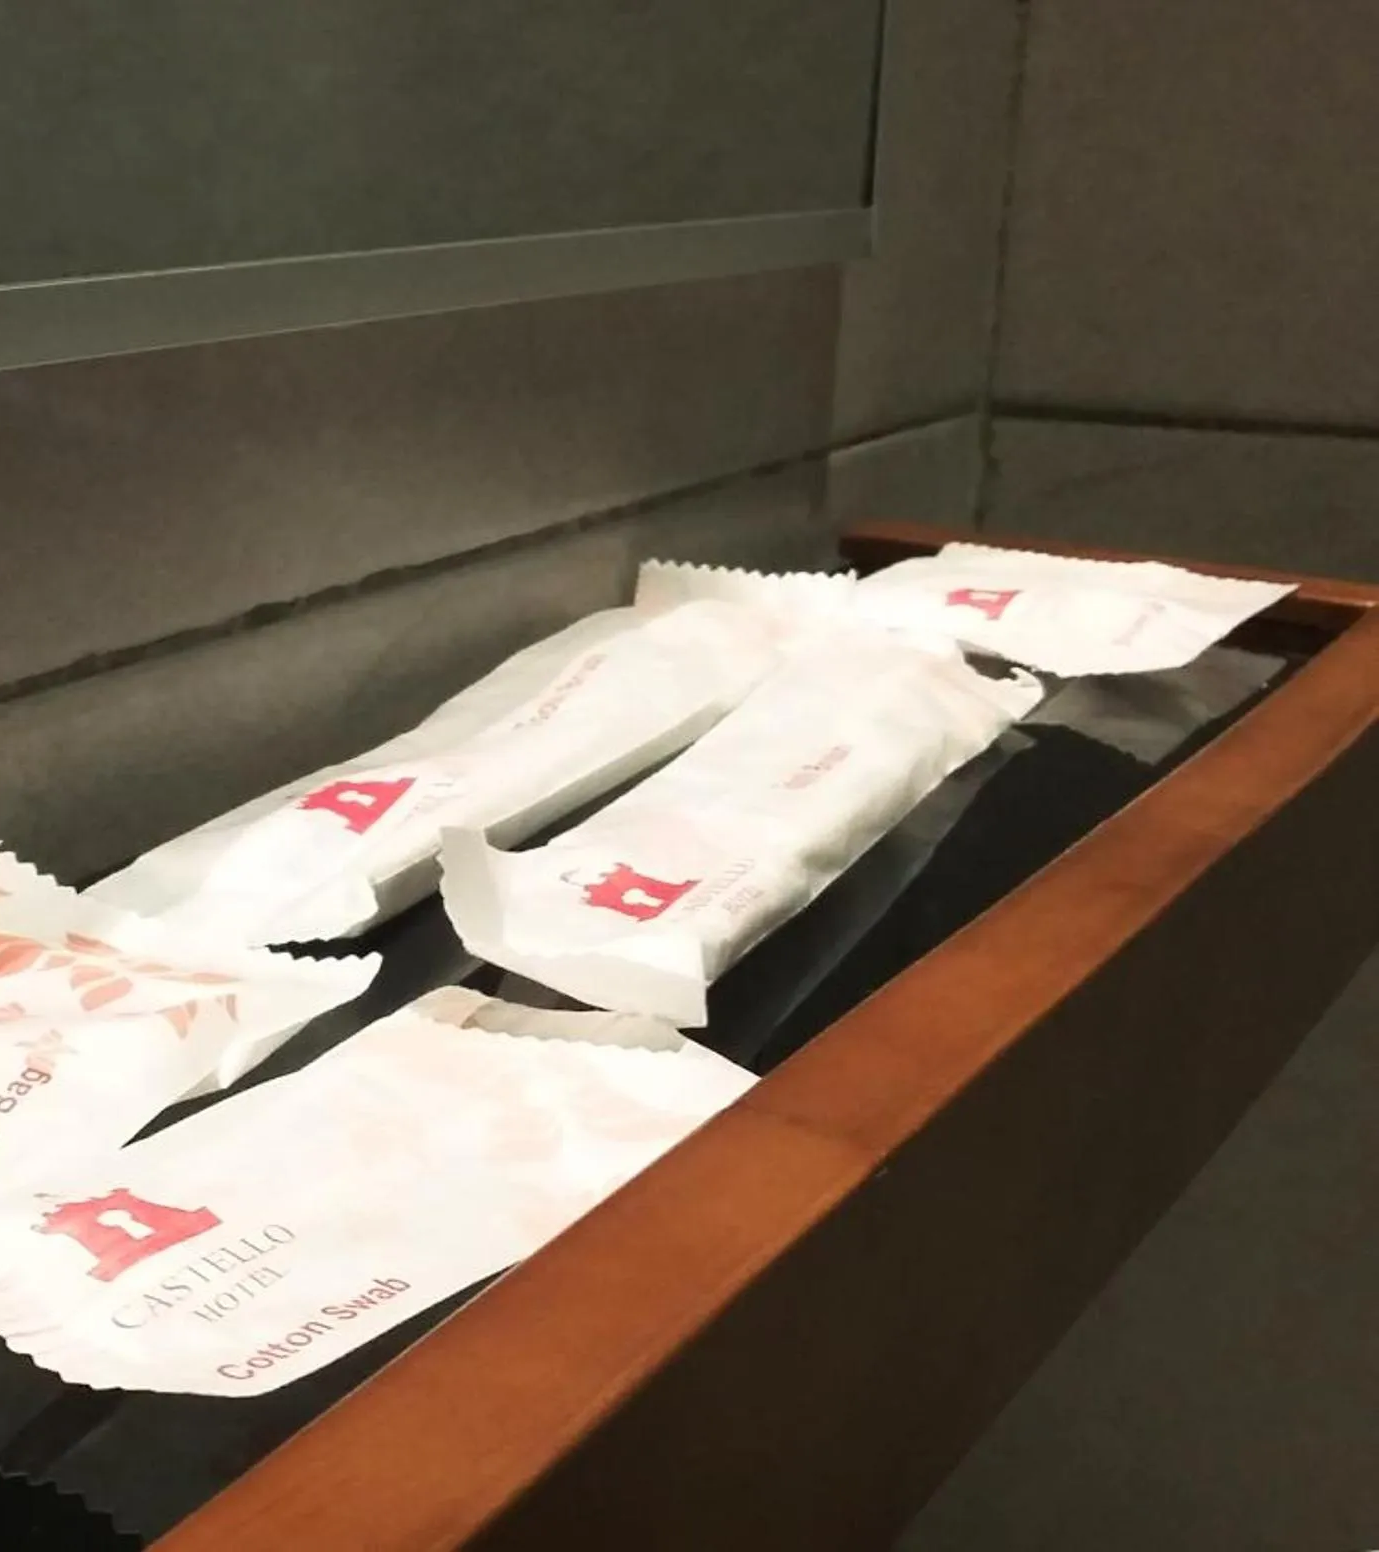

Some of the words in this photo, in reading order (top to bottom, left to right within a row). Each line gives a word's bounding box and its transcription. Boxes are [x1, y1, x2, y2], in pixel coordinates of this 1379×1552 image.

[110, 1223, 297, 1331] CASTELLO
[191, 1265, 290, 1324] HOTEL
[217, 1320, 331, 1382] Cotton
[323, 1274, 412, 1322] Swab
